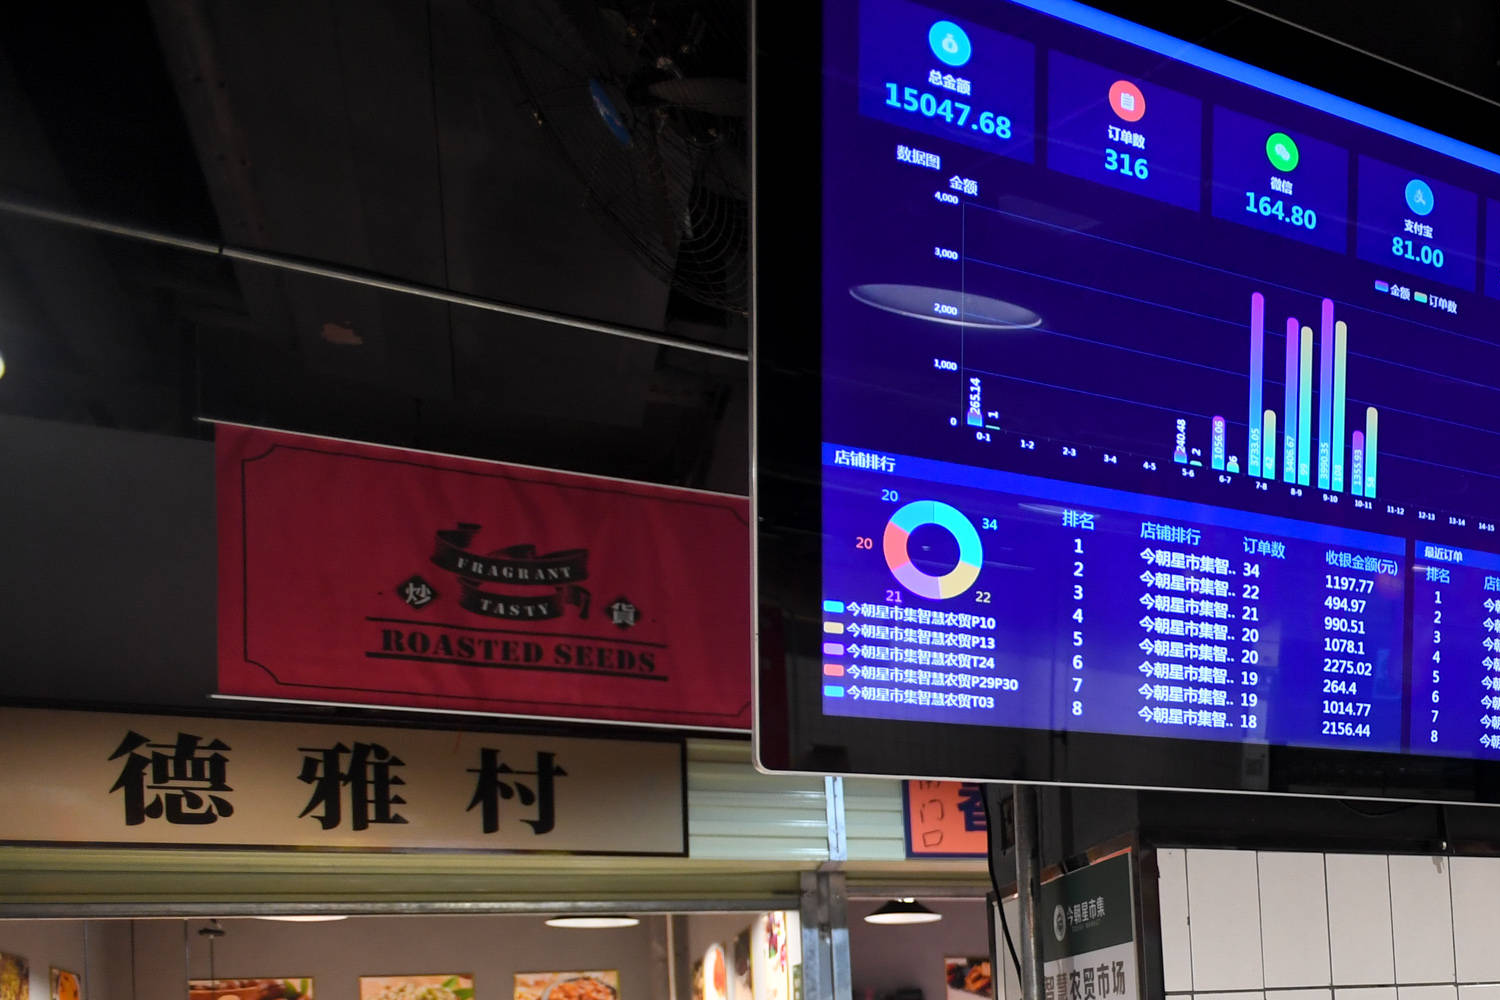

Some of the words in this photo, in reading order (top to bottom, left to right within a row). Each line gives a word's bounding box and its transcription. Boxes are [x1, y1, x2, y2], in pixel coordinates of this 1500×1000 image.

[928, 69, 971, 95] 总金额
[885, 82, 1012, 140] 15047.68
[1107, 125, 1146, 150] 订单数
[897, 145, 940, 170] 数据图
[1104, 149, 1149, 180] 316
[950, 175, 978, 195] 金额
[1270, 176, 1294, 195] 微信
[935, 191, 959, 204] 4,000
[1245, 192, 1317, 230] 164.80
[1404, 218, 1434, 238] 支付宝
[935, 247, 958, 260] 3,000
[1392, 238, 1444, 268] 81.00
[1390, 285, 1411, 301] 金额
[1428, 293, 1458, 314] 订单数
[934, 303, 957, 316] 2,000
[934, 358, 957, 371] 1,000
[970, 377, 981, 414] 265.14
[976, 432, 991, 442] 0-1
[834, 449, 896, 473] 店铺排行
[881, 489, 898, 502] 20
[1323, 494, 1338, 503] 9-10
[1355, 500, 1372, 509] 10-11
[981, 517, 998, 531] 34
[856, 537, 873, 550] 20
[1063, 509, 1095, 530] 排名
[1140, 522, 1201, 547] 店铺排行
[1243, 536, 1286, 559] 订单数
[1325, 550, 1398, 577] 收银金额(元)
[1424, 545, 1463, 564] 最近订单
[457, 558, 572, 581] FRAGRANT
[1074, 538, 1083, 554] 1
[1243, 563, 1260, 578] 34
[1325, 575, 1374, 595] 1197.77
[1426, 566, 1450, 584] 排名
[405, 582, 431, 605] 炒
[612, 602, 637, 626] 貨
[886, 589, 901, 603] 21
[975, 591, 991, 604] 22
[1325, 595, 1366, 614] 494.97
[480, 599, 550, 617] TASTY
[846, 602, 996, 630] 今朝星市集智慧农贸P10
[1073, 608, 1083, 624] 4
[1324, 637, 1365, 655] 1078.1
[1242, 606, 1259, 621] 21
[1324, 616, 1365, 635] 990.51
[846, 623, 996, 650] 今朝星市集智慧农贸P13
[382, 629, 543, 664] ROASTED
[553, 644, 656, 673] SEEDS
[846, 643, 995, 670] 今朝星市集智慧农贸T24
[846, 664, 1019, 692] 今朝星市集智慧农贸P29P30
[1323, 658, 1372, 677] 2275.02
[1241, 670, 1258, 685] 19
[1323, 679, 1357, 695] 264.4
[846, 685, 995, 710] 今朝星市集智慧农贸T03
[1322, 721, 1371, 738] 2156.44
[108, 730, 568, 836] 德雅村
[1067, 896, 1105, 925] 今朝星市集
